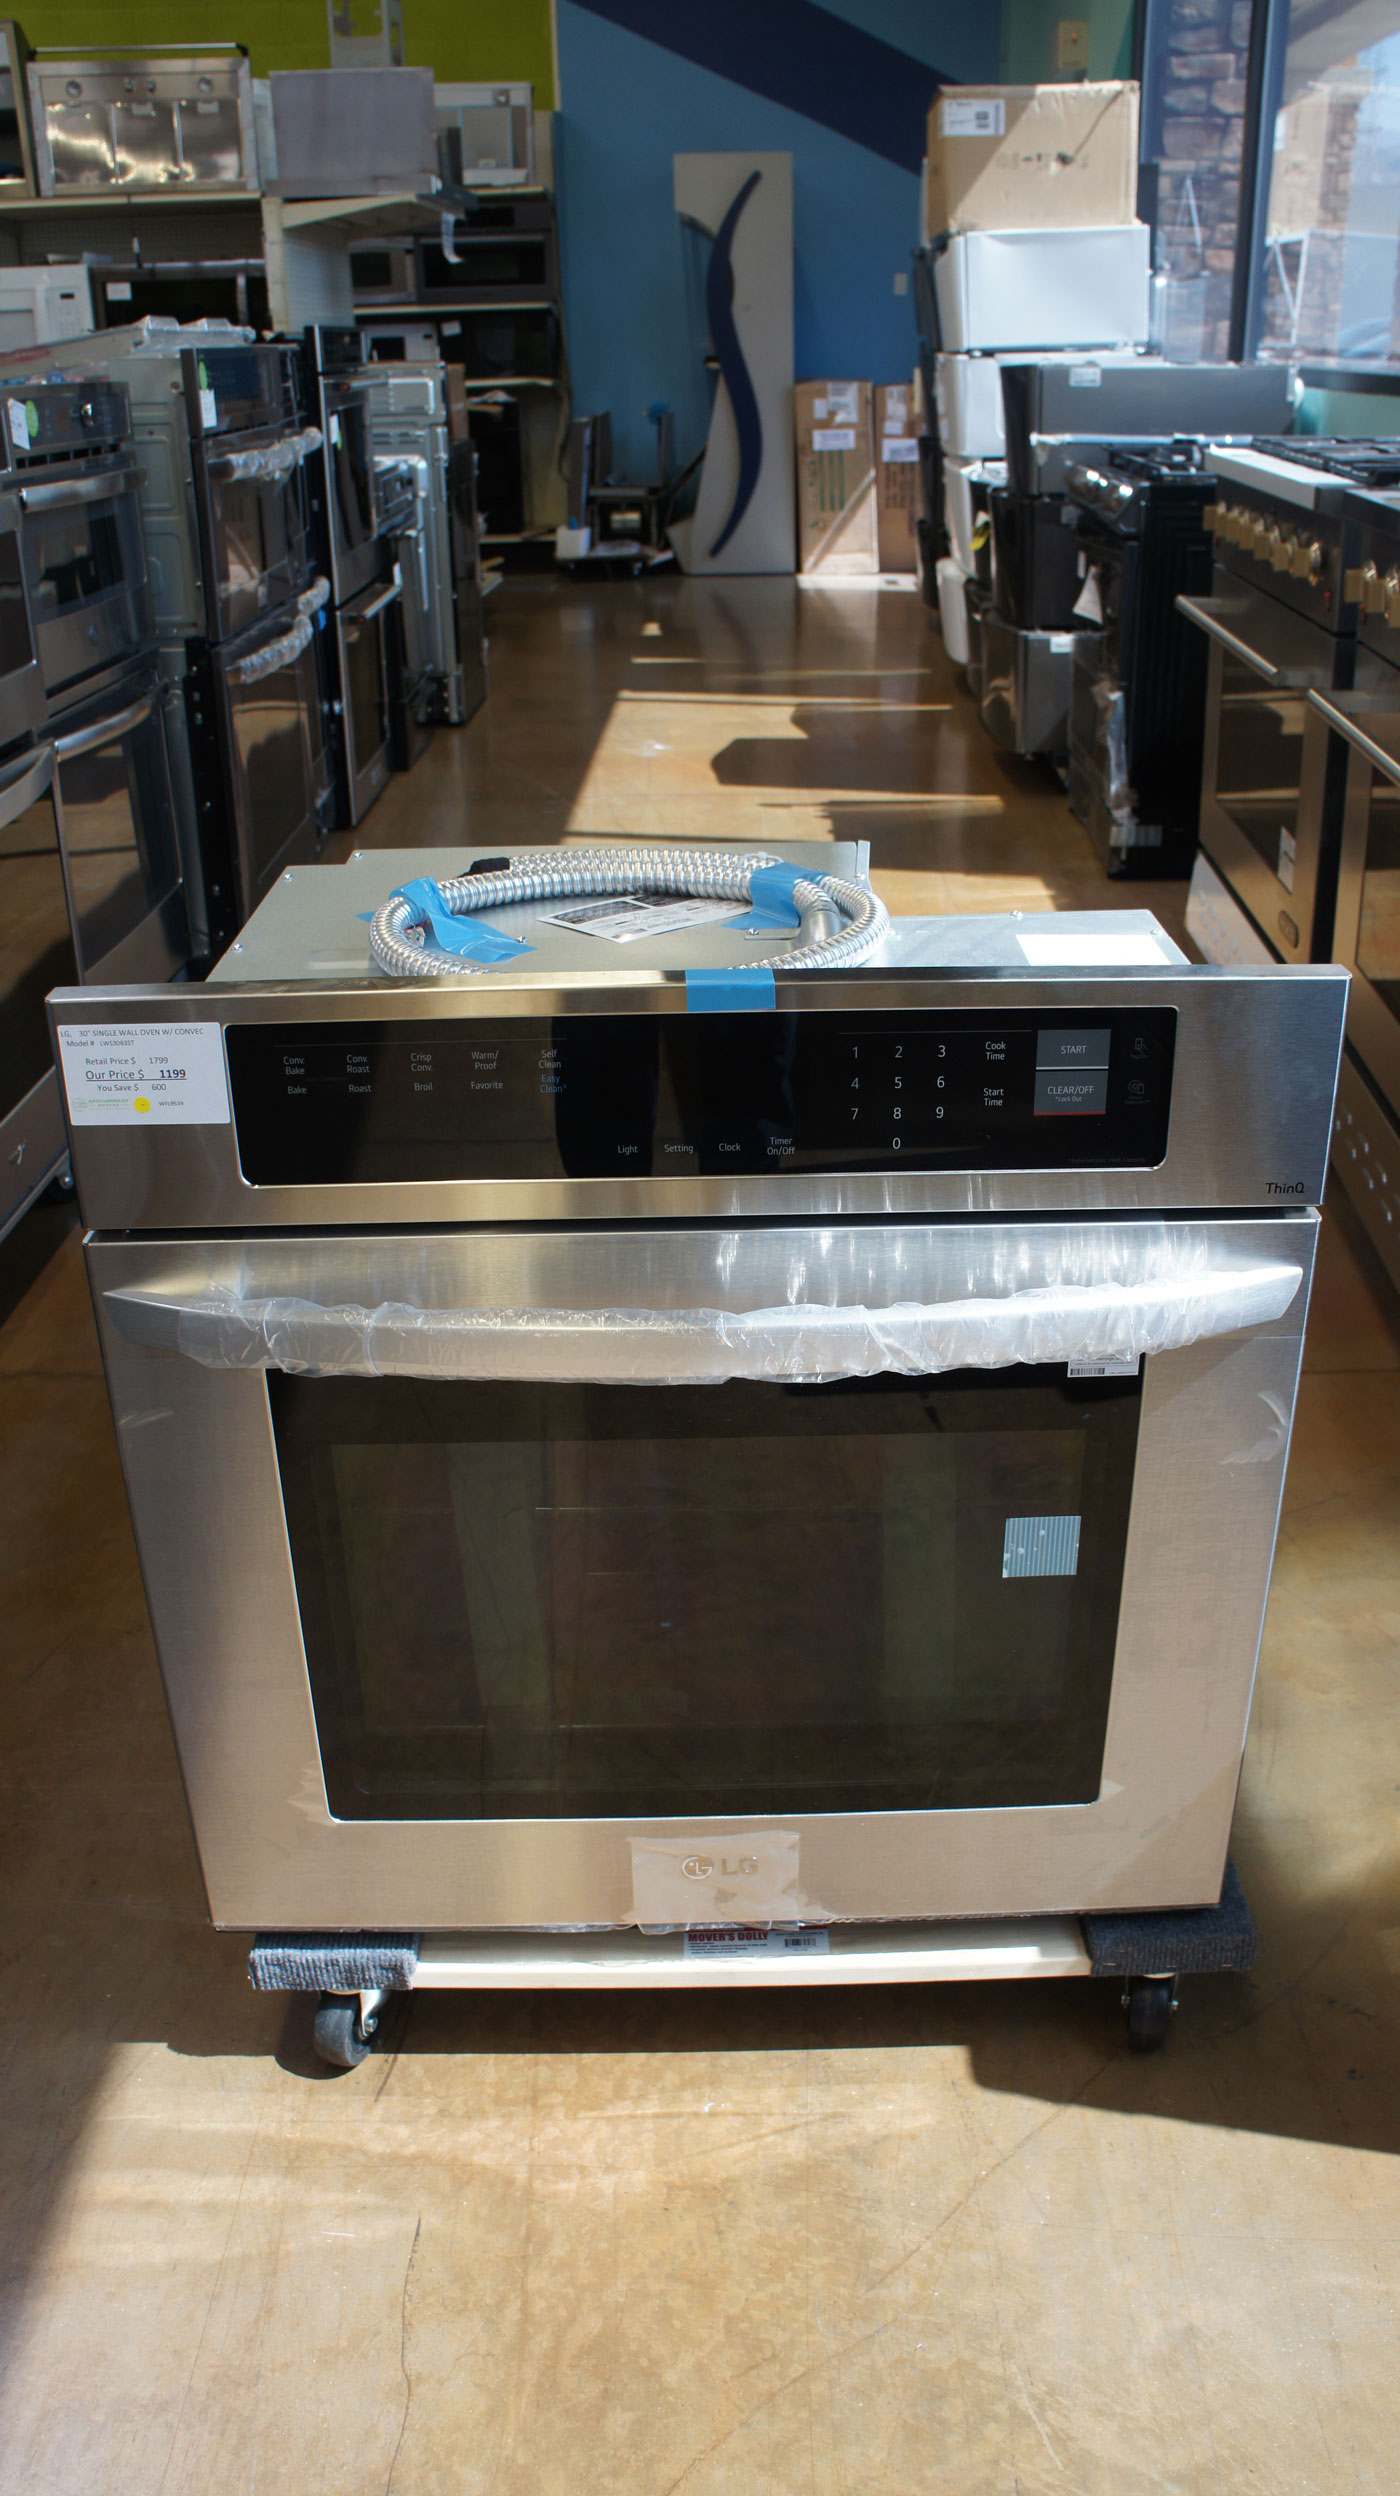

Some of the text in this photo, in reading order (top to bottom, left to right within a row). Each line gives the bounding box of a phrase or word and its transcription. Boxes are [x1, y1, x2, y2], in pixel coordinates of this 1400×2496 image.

[92, 1029, 118, 1037] SINGLE
[161, 1028, 173, 1036] W/
[985, 1041, 1006, 1050] Cook
[1061, 1045, 1087, 1054] START
[471, 1050, 499, 1061] Warm/
[541, 1049, 558, 1058] Self
[852, 1045, 946, 1059] 1 2 3
[985, 1052, 1005, 1060] Time
[130, 1057, 136, 1065] $
[283, 1056, 305, 1065] Conv.
[346, 1054, 368, 1063] Conv.
[410, 1053, 432, 1063] Crisp
[347, 1064, 370, 1074] Roast
[411, 1063, 433, 1072] Conv.
[474, 1061, 497, 1070] Proof
[538, 1060, 561, 1069] Clean
[85, 1069, 186, 1080] Our Price $ 1199
[285, 1066, 305, 1075] Bake
[541, 1074, 560, 1084] Easy
[851, 1076, 945, 1089] 4 5 6
[134, 1084, 139, 1092] $
[348, 1083, 372, 1093] Roast
[414, 1082, 433, 1091] Broil
[470, 1080, 504, 1090] Favorite
[287, 1085, 307, 1095] Bake
[983, 1088, 1004, 1096] Start
[1047, 1085, 1095, 1095] CLEAR/OFF
[984, 1098, 1003, 1106] Time
[851, 1106, 944, 1120] 7 8 9
[770, 1136, 792, 1146] Timer
[892, 1137, 901, 1150] 0
[617, 1145, 638, 1154] Light
[664, 1144, 694, 1154] Setting
[718, 1143, 741, 1151] Clock
[766, 1146, 795, 1155] On/Off
[1265, 1182, 1305, 1194] ThinQ
[721, 1857, 759, 1876] LG
[688, 1932, 736, 1942] MOVER'S
[737, 1931, 769, 1940] DOLLY
